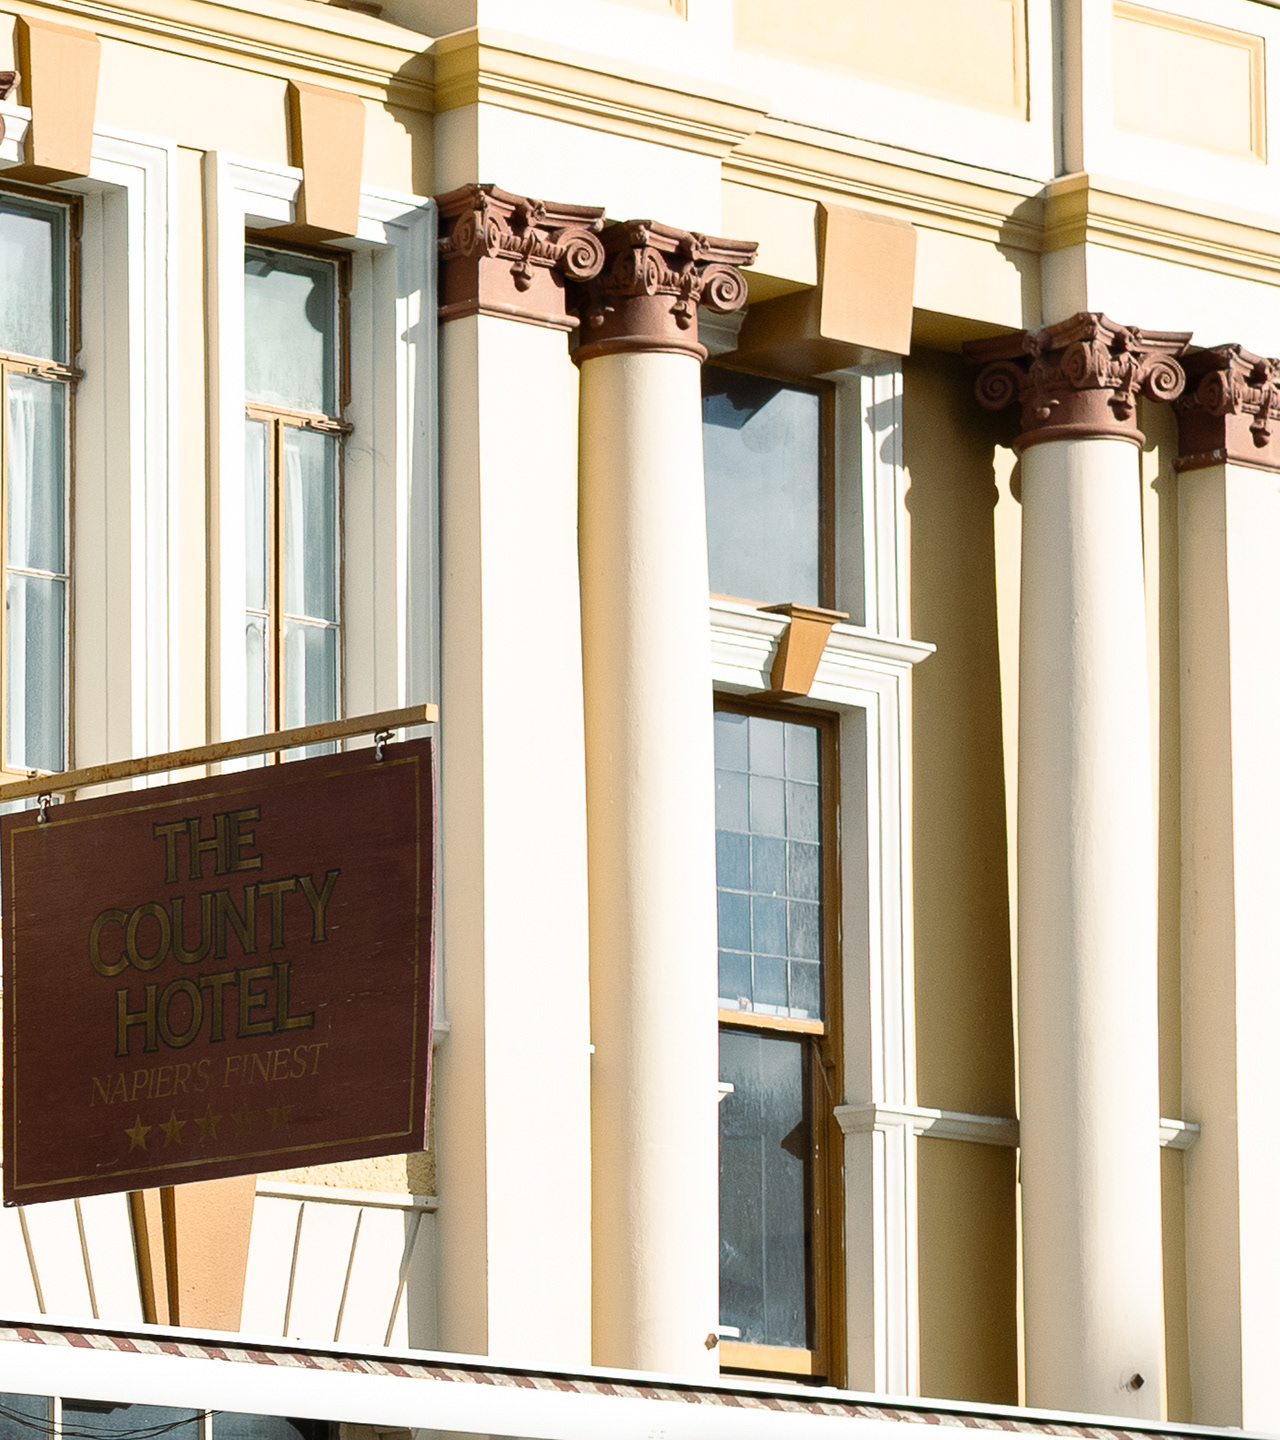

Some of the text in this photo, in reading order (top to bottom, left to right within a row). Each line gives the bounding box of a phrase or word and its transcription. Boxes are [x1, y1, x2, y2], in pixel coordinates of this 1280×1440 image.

[153, 805, 264, 884] THE
[88, 868, 340, 978] COUNTY
[114, 962, 315, 1058] HOTEL
[89, 1042, 329, 1107] NAPIER'S FINEST
